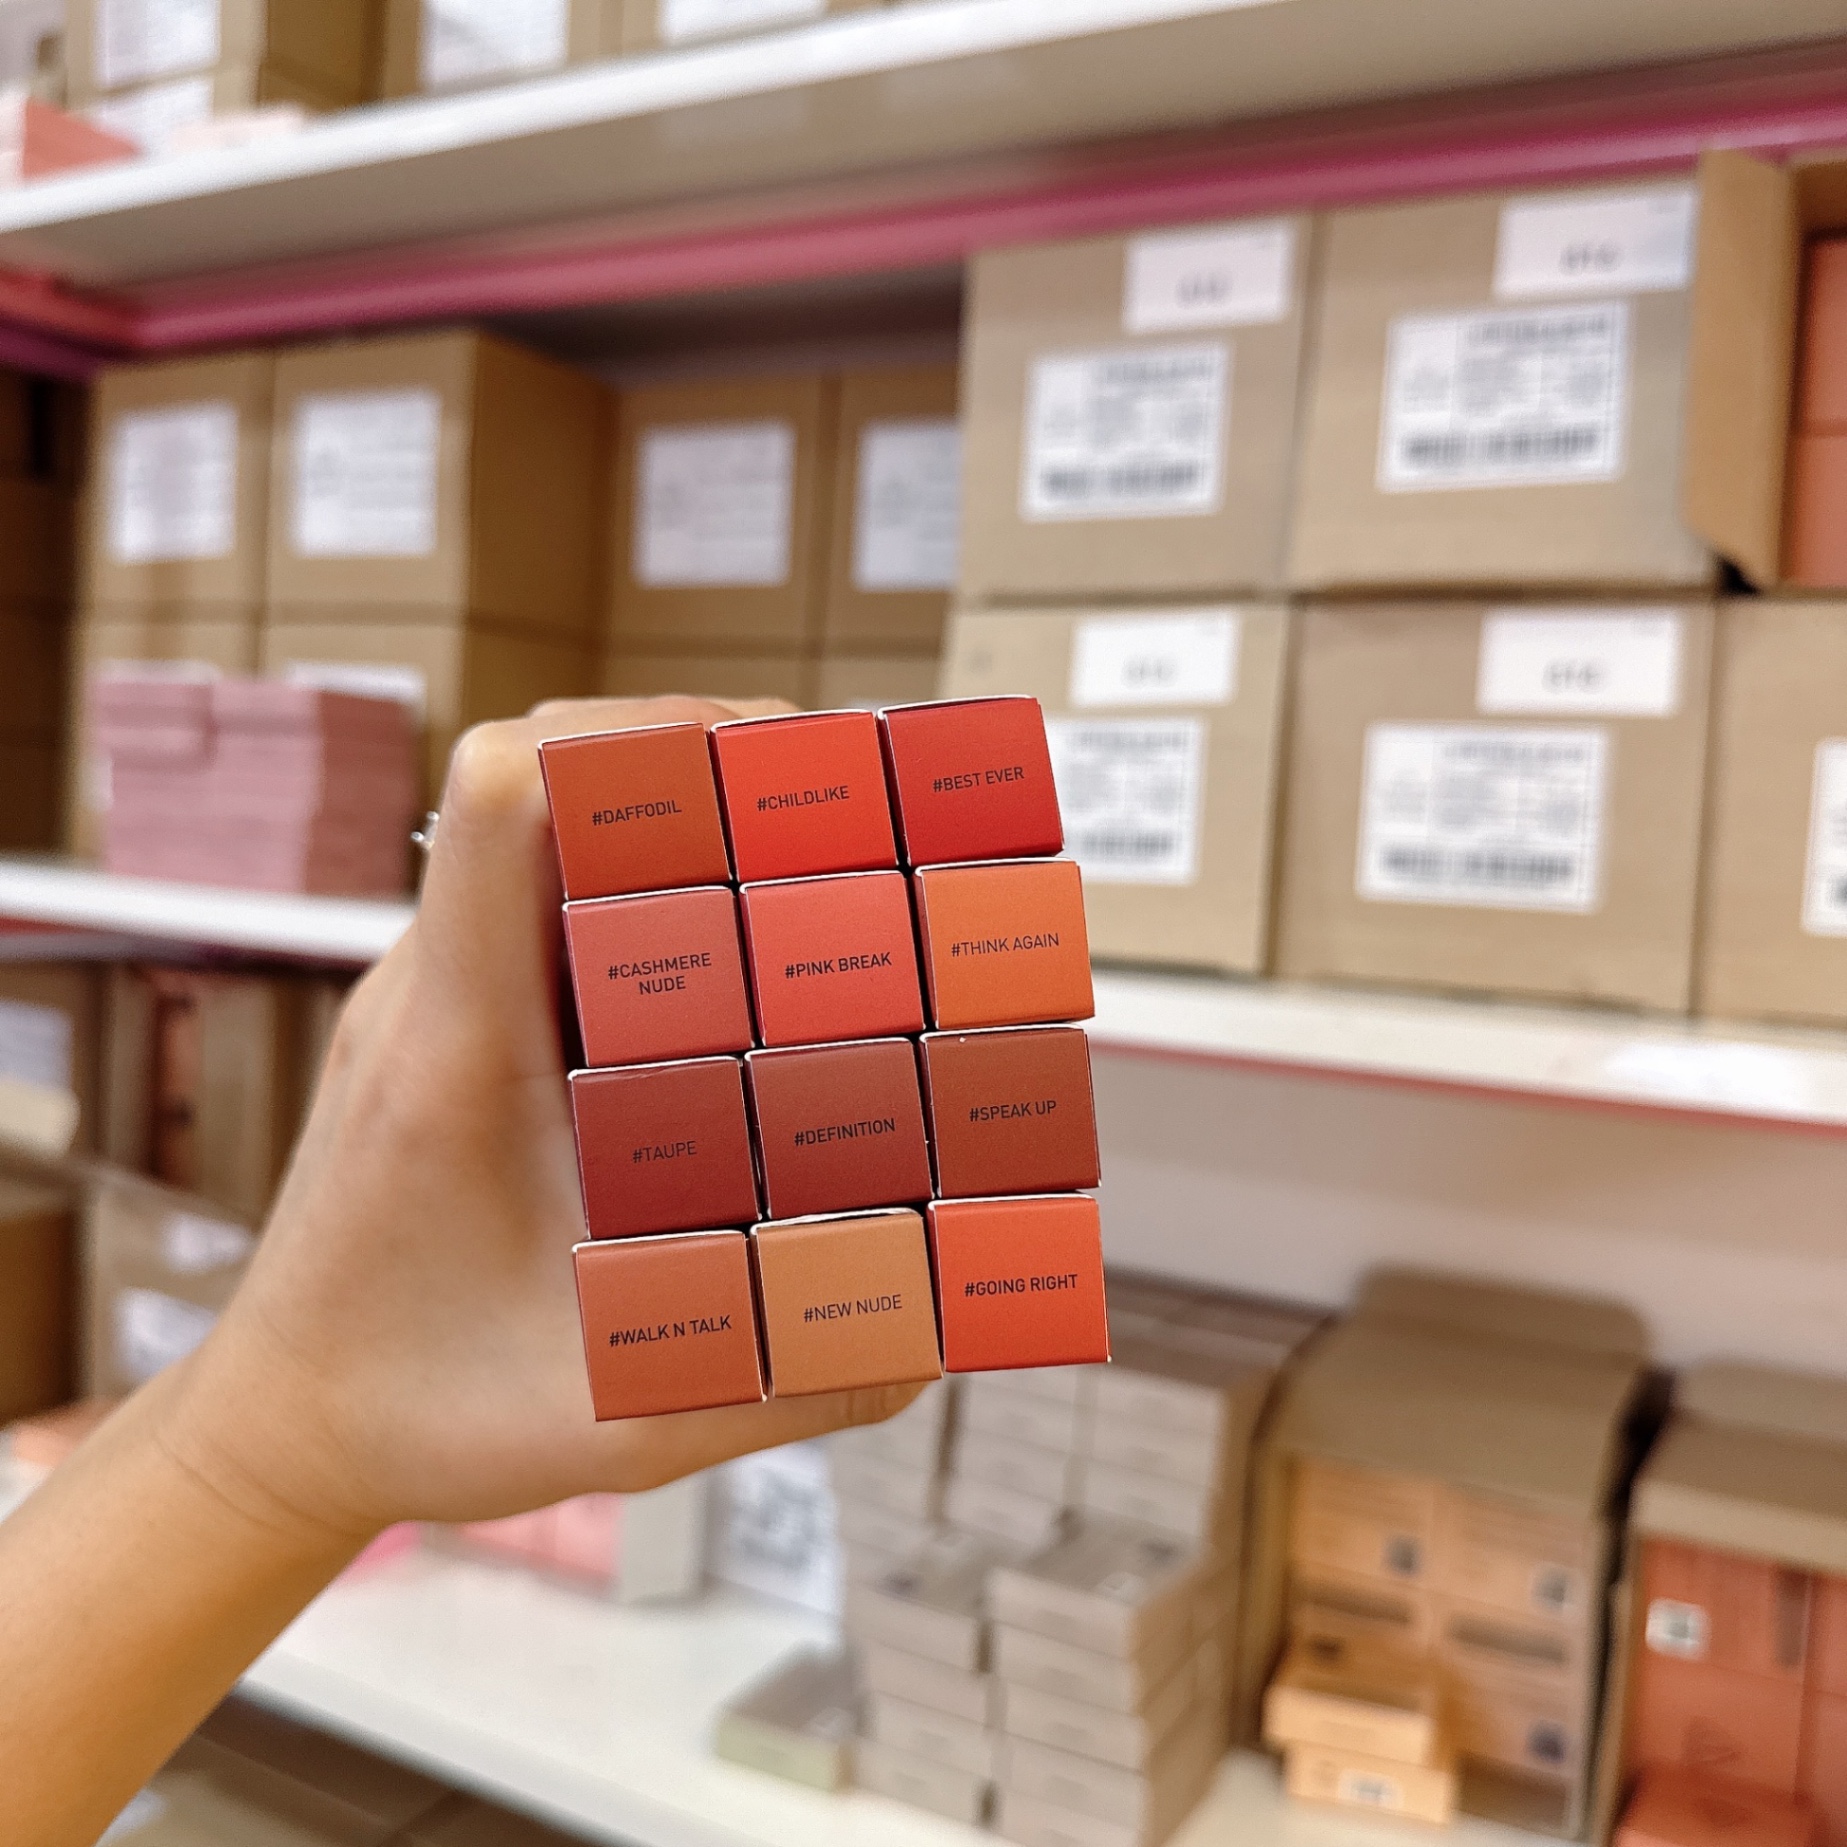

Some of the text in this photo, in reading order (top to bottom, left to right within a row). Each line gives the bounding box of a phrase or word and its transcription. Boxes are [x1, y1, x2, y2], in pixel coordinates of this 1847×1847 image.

[933, 767, 1024, 792] #BEST EVER
[757, 786, 849, 811] #CHILDLIKE
[592, 800, 681, 825] #DAFFODIL
[952, 933, 1059, 956] #THINK AGAIN
[608, 952, 712, 980] #CASHMERE
[785, 952, 892, 978] #PINK BREAK
[639, 975, 686, 995] NUDE
[970, 1100, 1057, 1121] #SPEAK UP
[795, 1118, 895, 1146] #DEFINITION
[633, 1141, 697, 1163] #TAUPE
[965, 1274, 1077, 1296] #GOING RIGHT
[804, 1294, 902, 1322] #NEW NUDE
[610, 1315, 731, 1347] #WALK N TALK
